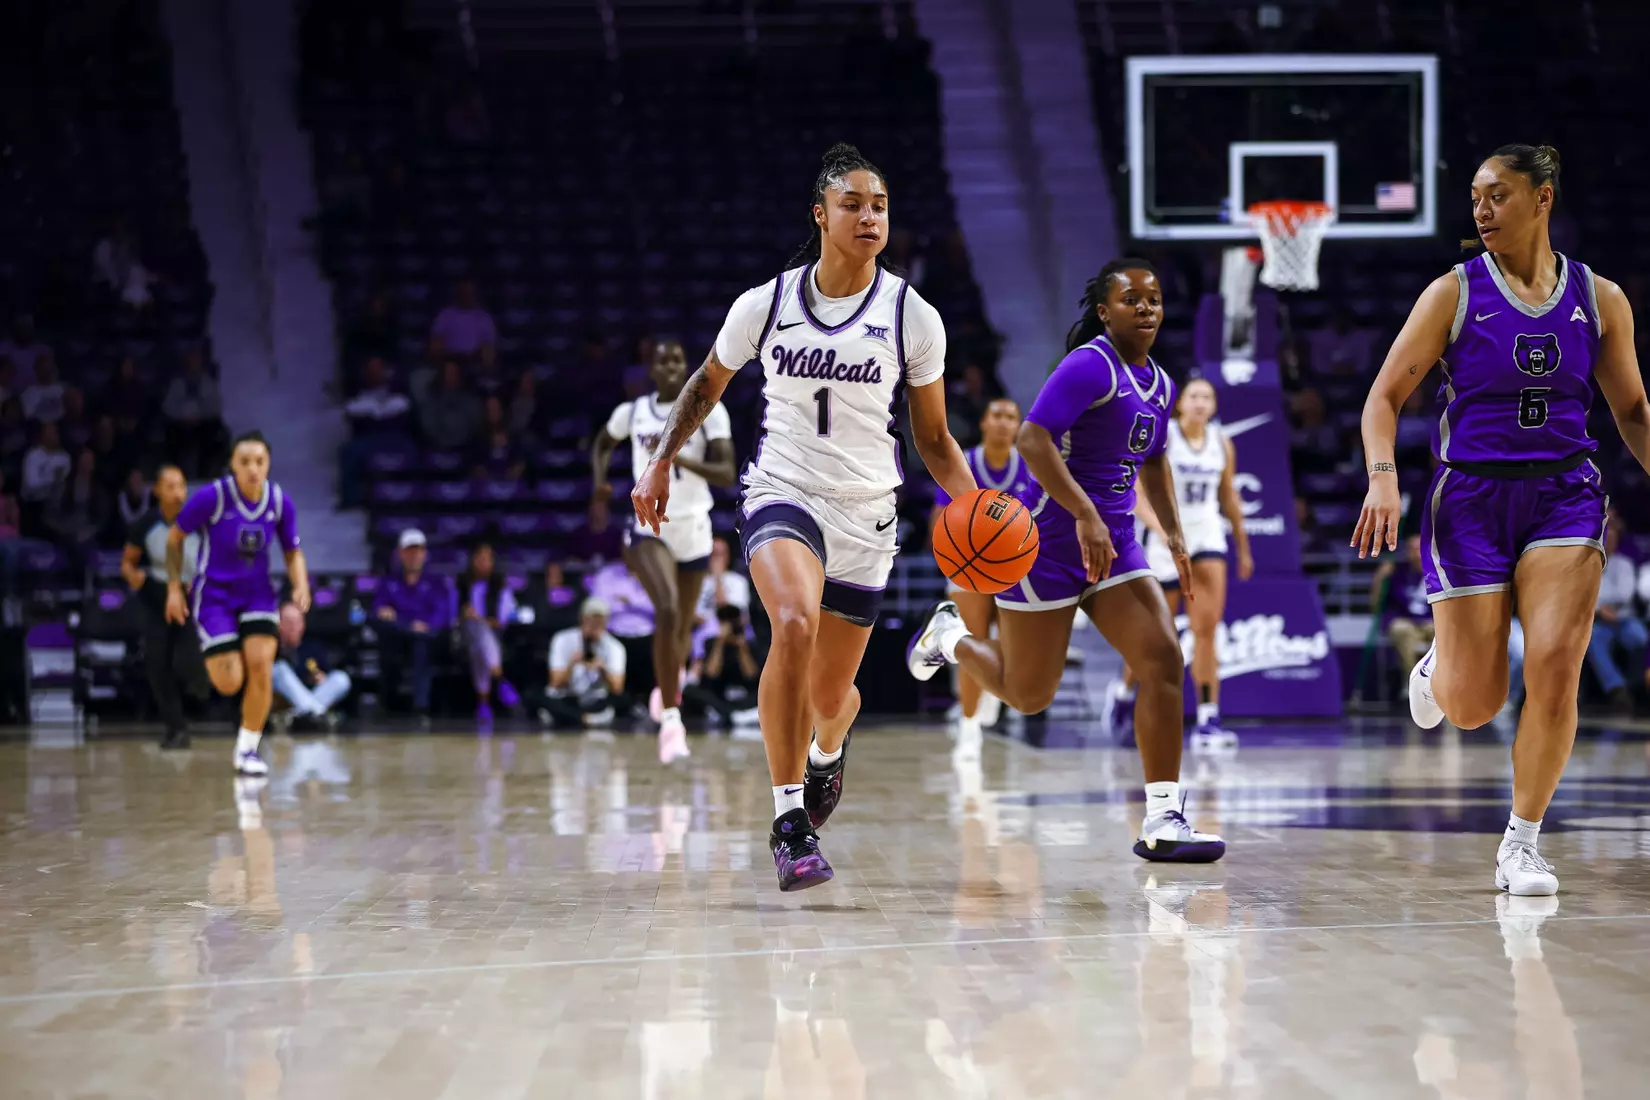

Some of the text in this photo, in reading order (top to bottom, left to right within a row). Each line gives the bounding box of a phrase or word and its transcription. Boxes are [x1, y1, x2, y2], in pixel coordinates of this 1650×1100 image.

[771, 344, 882, 384] Wildcats
[813, 386, 831, 437] 1
[1518, 387, 1551, 429] 6
[1111, 458, 1136, 493] 3
